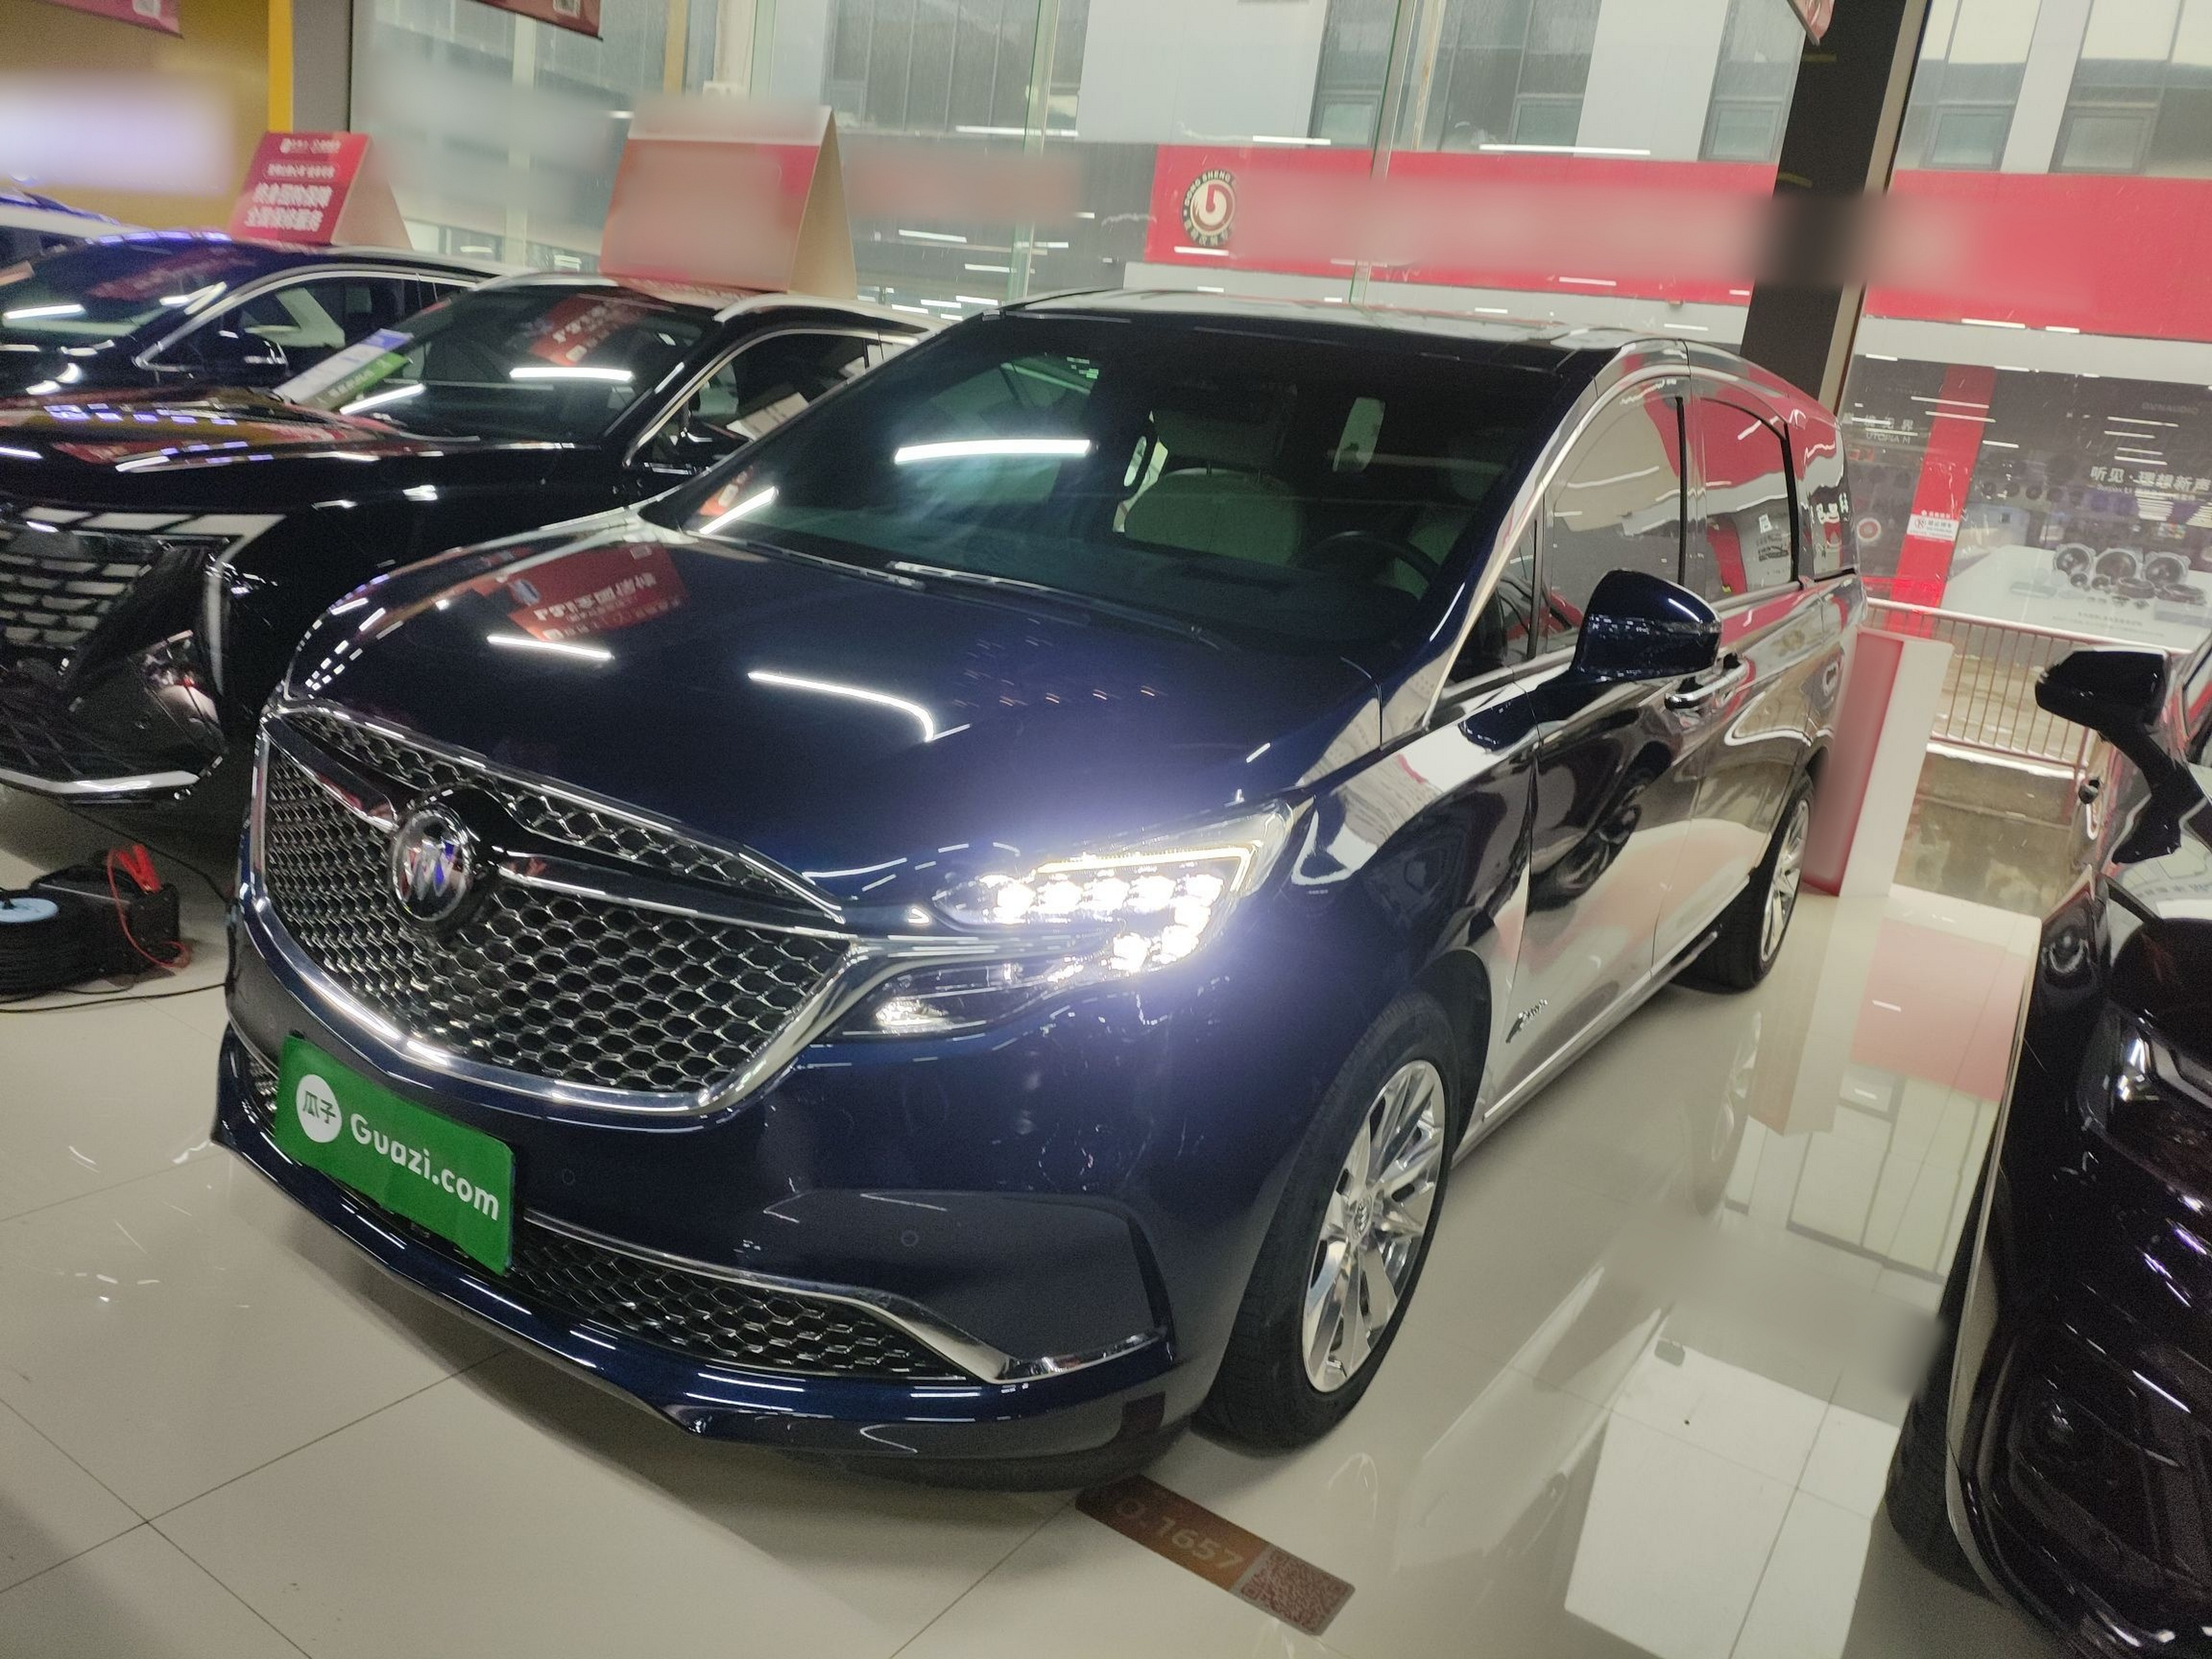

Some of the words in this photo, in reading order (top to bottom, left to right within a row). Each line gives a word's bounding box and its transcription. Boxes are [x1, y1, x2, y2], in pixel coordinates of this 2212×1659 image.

[302, 1090, 337, 1124] 瓜子
[350, 1113, 499, 1221] Guazi.com
[1158, 1516, 1244, 1568] 1657
